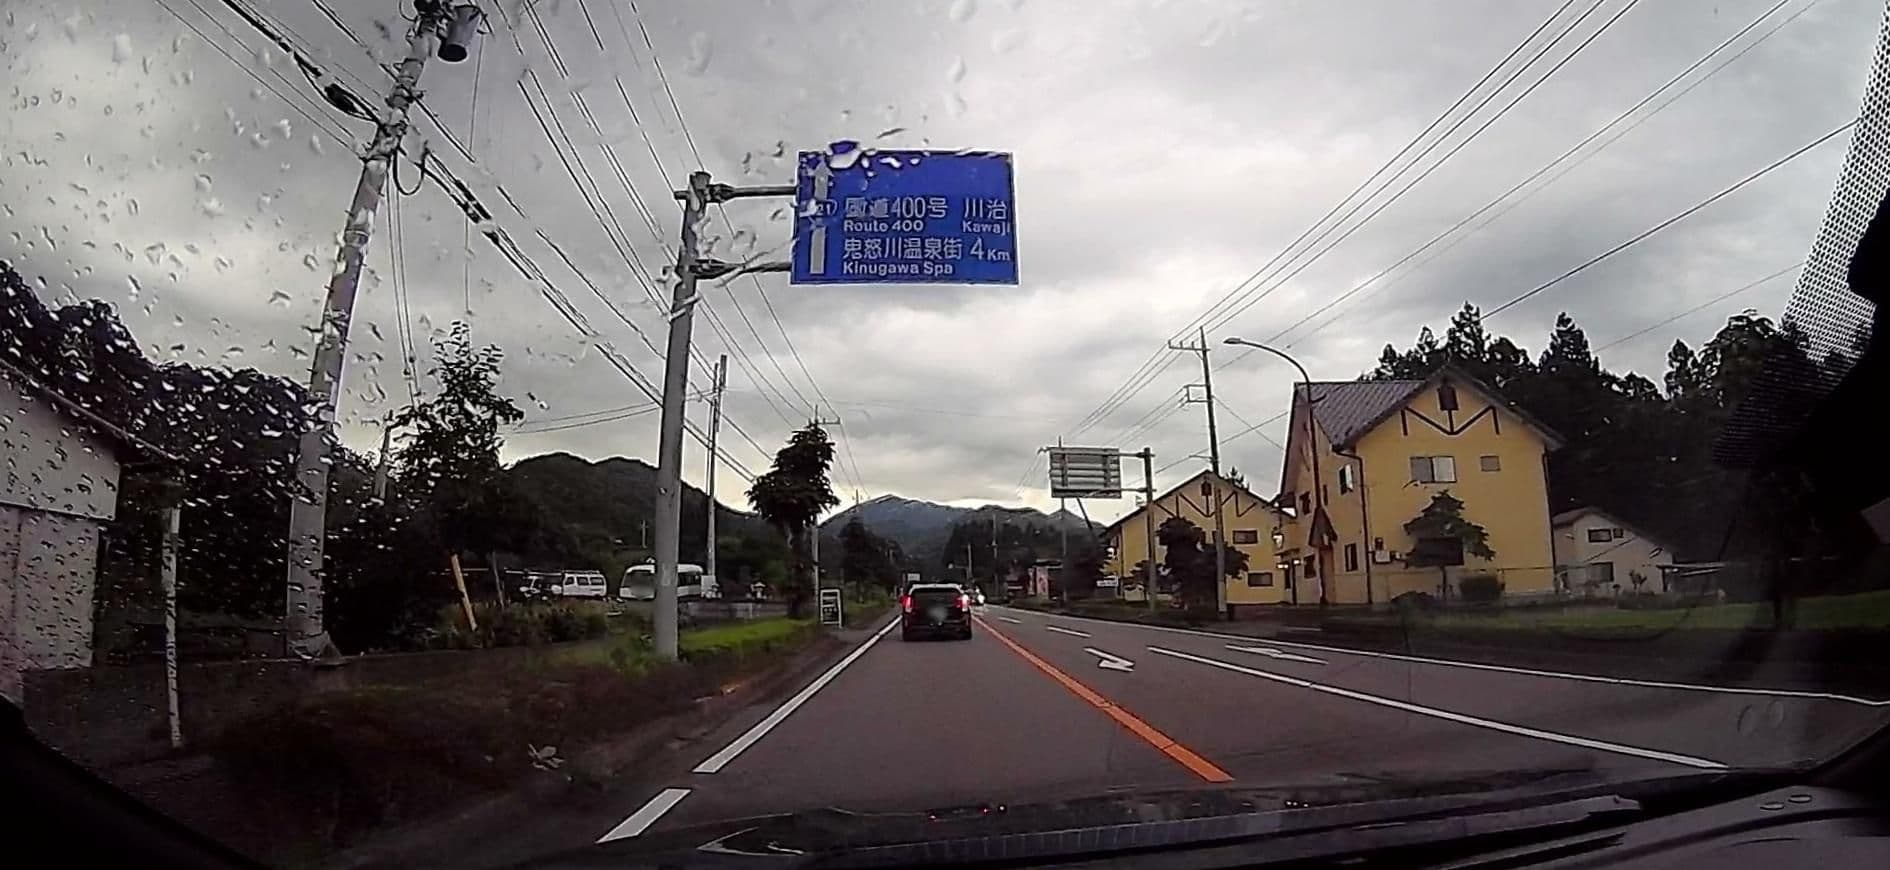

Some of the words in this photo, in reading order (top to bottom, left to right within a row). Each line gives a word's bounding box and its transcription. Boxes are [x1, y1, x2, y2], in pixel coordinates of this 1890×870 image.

[964, 197, 1008, 219] 川治
[843, 220, 889, 232] Route
[891, 220, 924, 232] 400
[962, 220, 1010, 235] Kawaji
[843, 238, 963, 260] 鬼怒川温泉街
[970, 238, 985, 260] 4
[843, 261, 919, 276] Kinugawa
[923, 263, 953, 276] Spa
